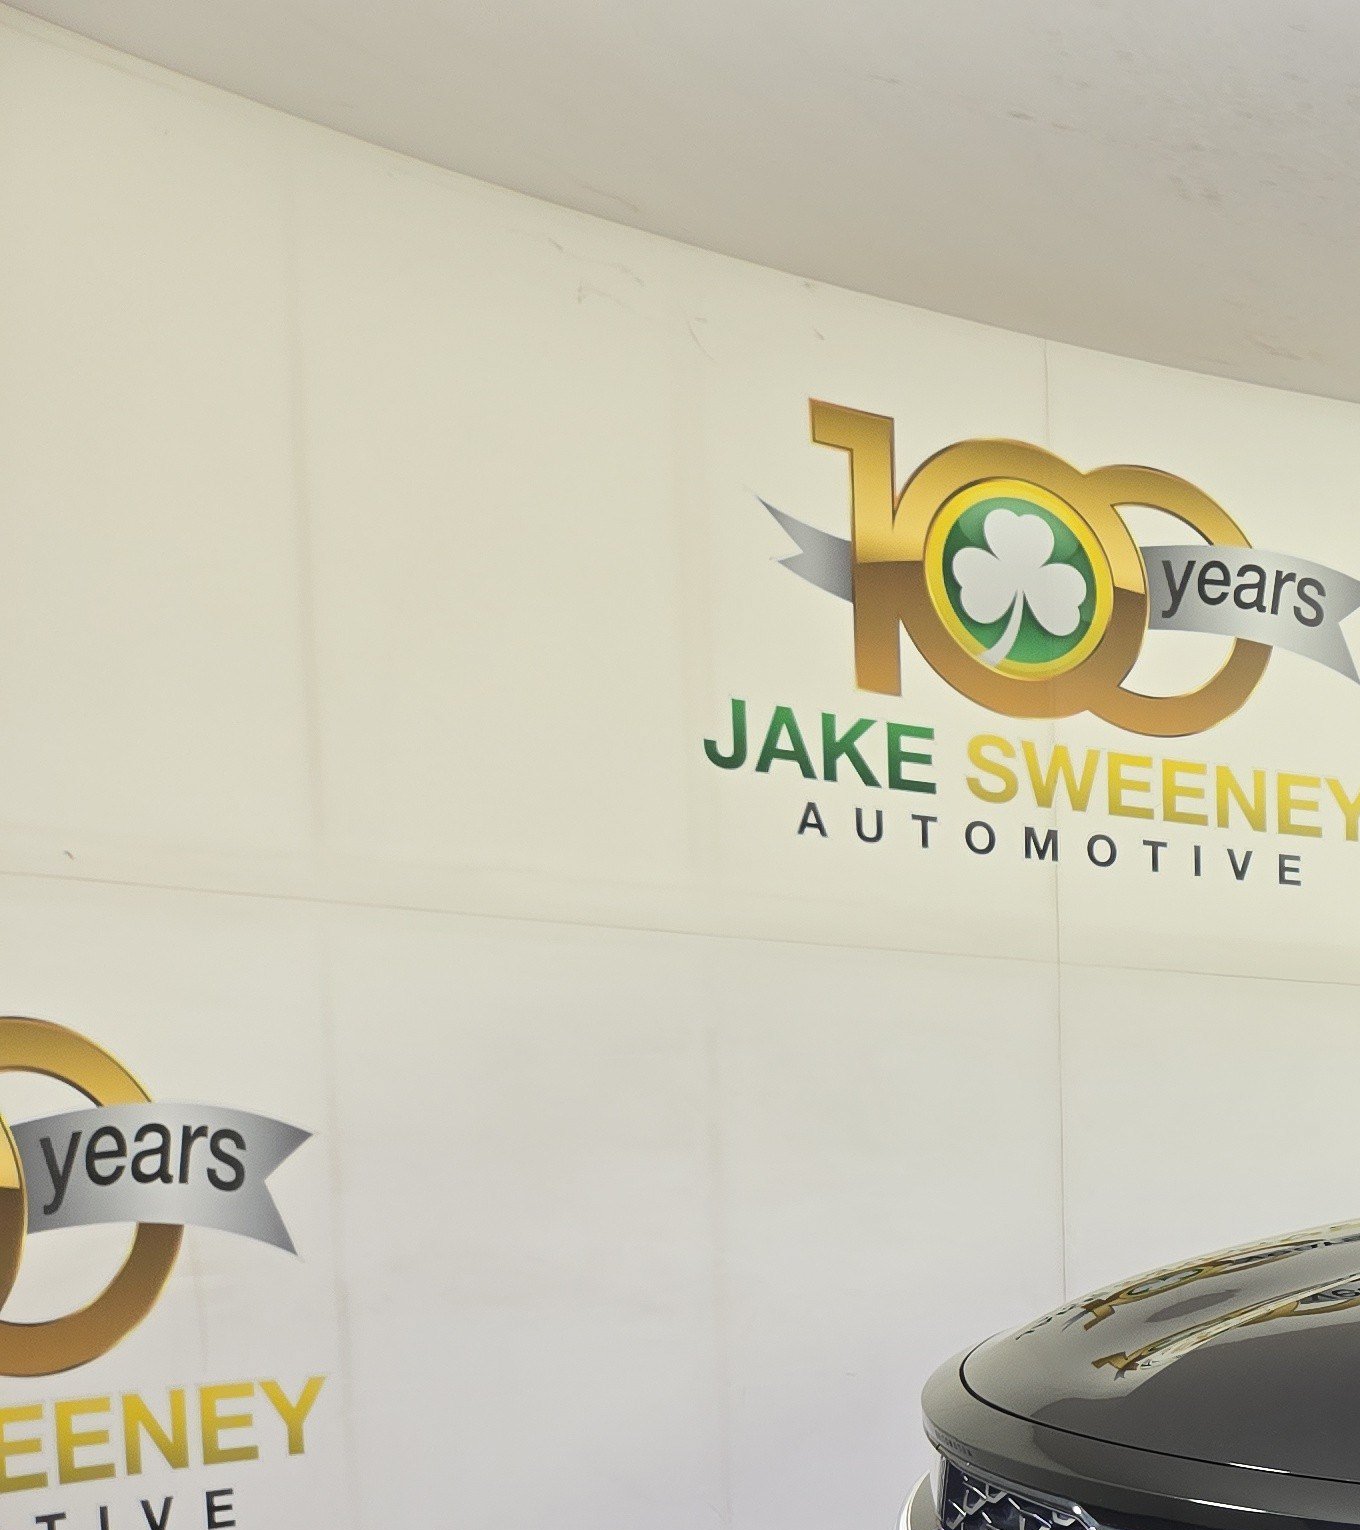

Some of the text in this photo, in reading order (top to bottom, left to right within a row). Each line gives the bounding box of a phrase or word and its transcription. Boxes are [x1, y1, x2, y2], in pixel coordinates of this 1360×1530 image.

[1159, 555, 1327, 628] years
[703, 697, 938, 795] JAKE
[797, 801, 1303, 887] AUTOMOTIVE
[39, 1121, 249, 1217] years
